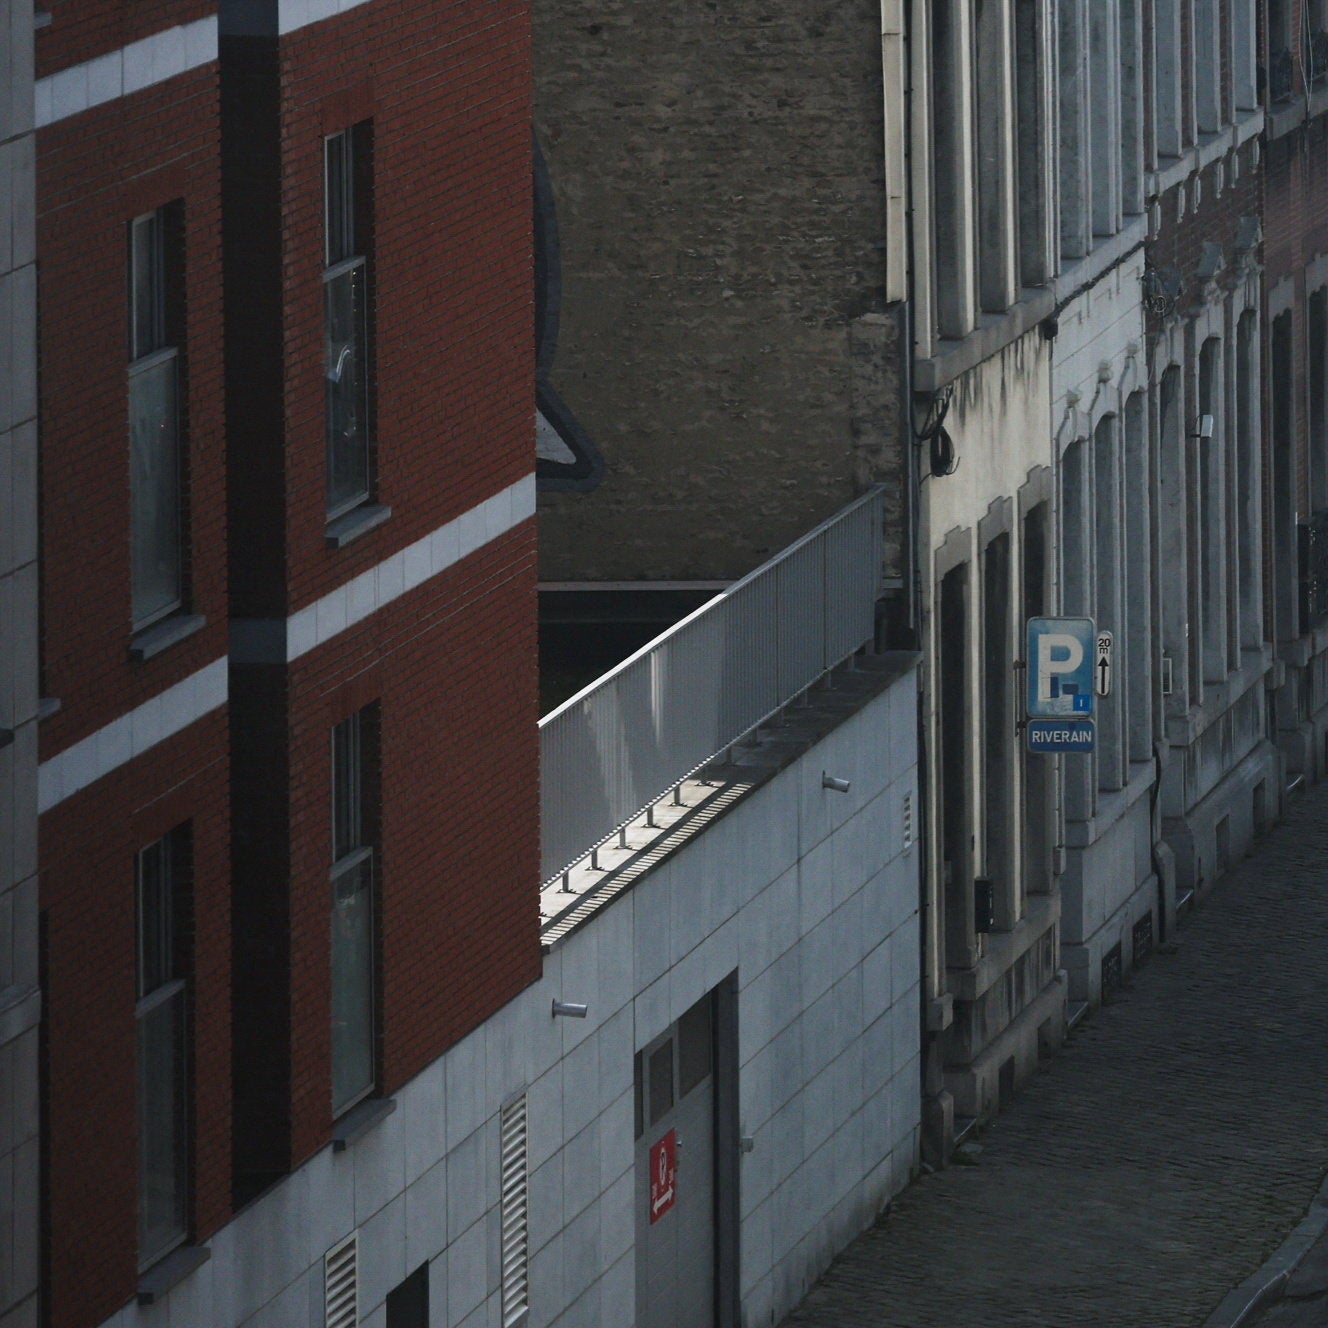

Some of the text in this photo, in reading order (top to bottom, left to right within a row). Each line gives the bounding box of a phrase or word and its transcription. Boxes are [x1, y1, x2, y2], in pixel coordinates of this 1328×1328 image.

[1098, 638, 1111, 648] 20
[1038, 634, 1084, 702] P
[1032, 731, 1092, 743] RIVERAIN
